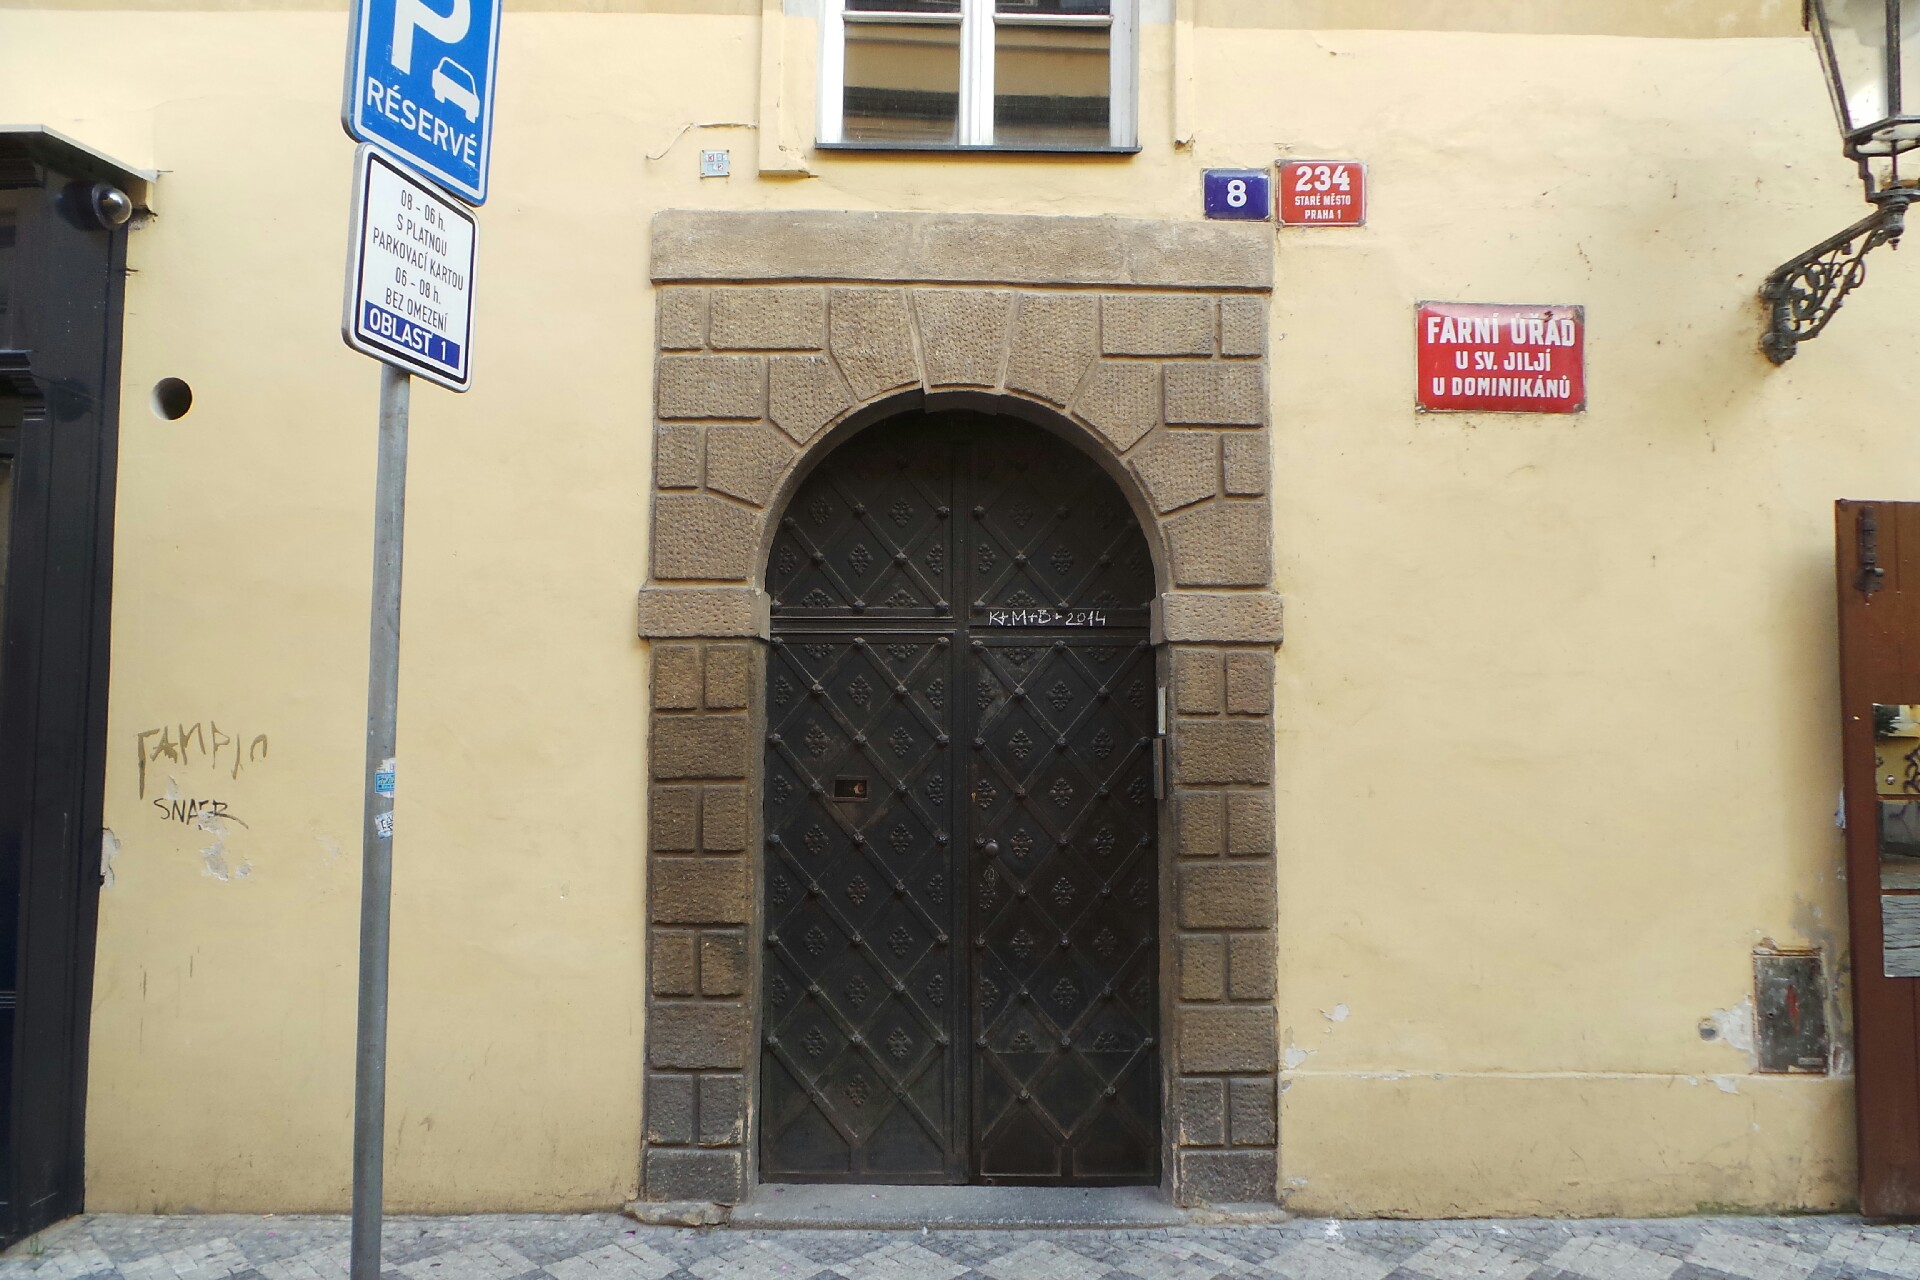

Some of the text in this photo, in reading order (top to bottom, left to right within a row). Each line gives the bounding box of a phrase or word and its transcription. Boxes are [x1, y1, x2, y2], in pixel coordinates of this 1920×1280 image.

[391, 0, 471, 75] P
[366, 76, 478, 168] RÉSERVÉ
[1226, 179, 1248, 208] 8
[1295, 165, 1351, 192] 234
[401, 189, 413, 211] 08
[425, 204, 436, 225] 06
[438, 212, 446, 232] h.
[1294, 192, 1351, 206] STARÉ MĚSTO
[1304, 209, 1342, 219] PRAHA 1
[397, 213, 447, 257] S PLATNOU
[373, 226, 464, 291] PARKOVACÍ KARTOU
[395, 266, 408, 287] 06
[419, 278, 431, 299] 08
[433, 285, 441, 305] h.
[385, 287, 448, 332] BEZ OMEZENÍ
[369, 307, 447, 361] OBLAST 1
[1427, 312, 1576, 347] FARNÍ ÚŘÁD
[1455, 348, 1551, 371] U SV. JILJÍ
[1432, 374, 1571, 399] U DOMINIKÁNŮ
